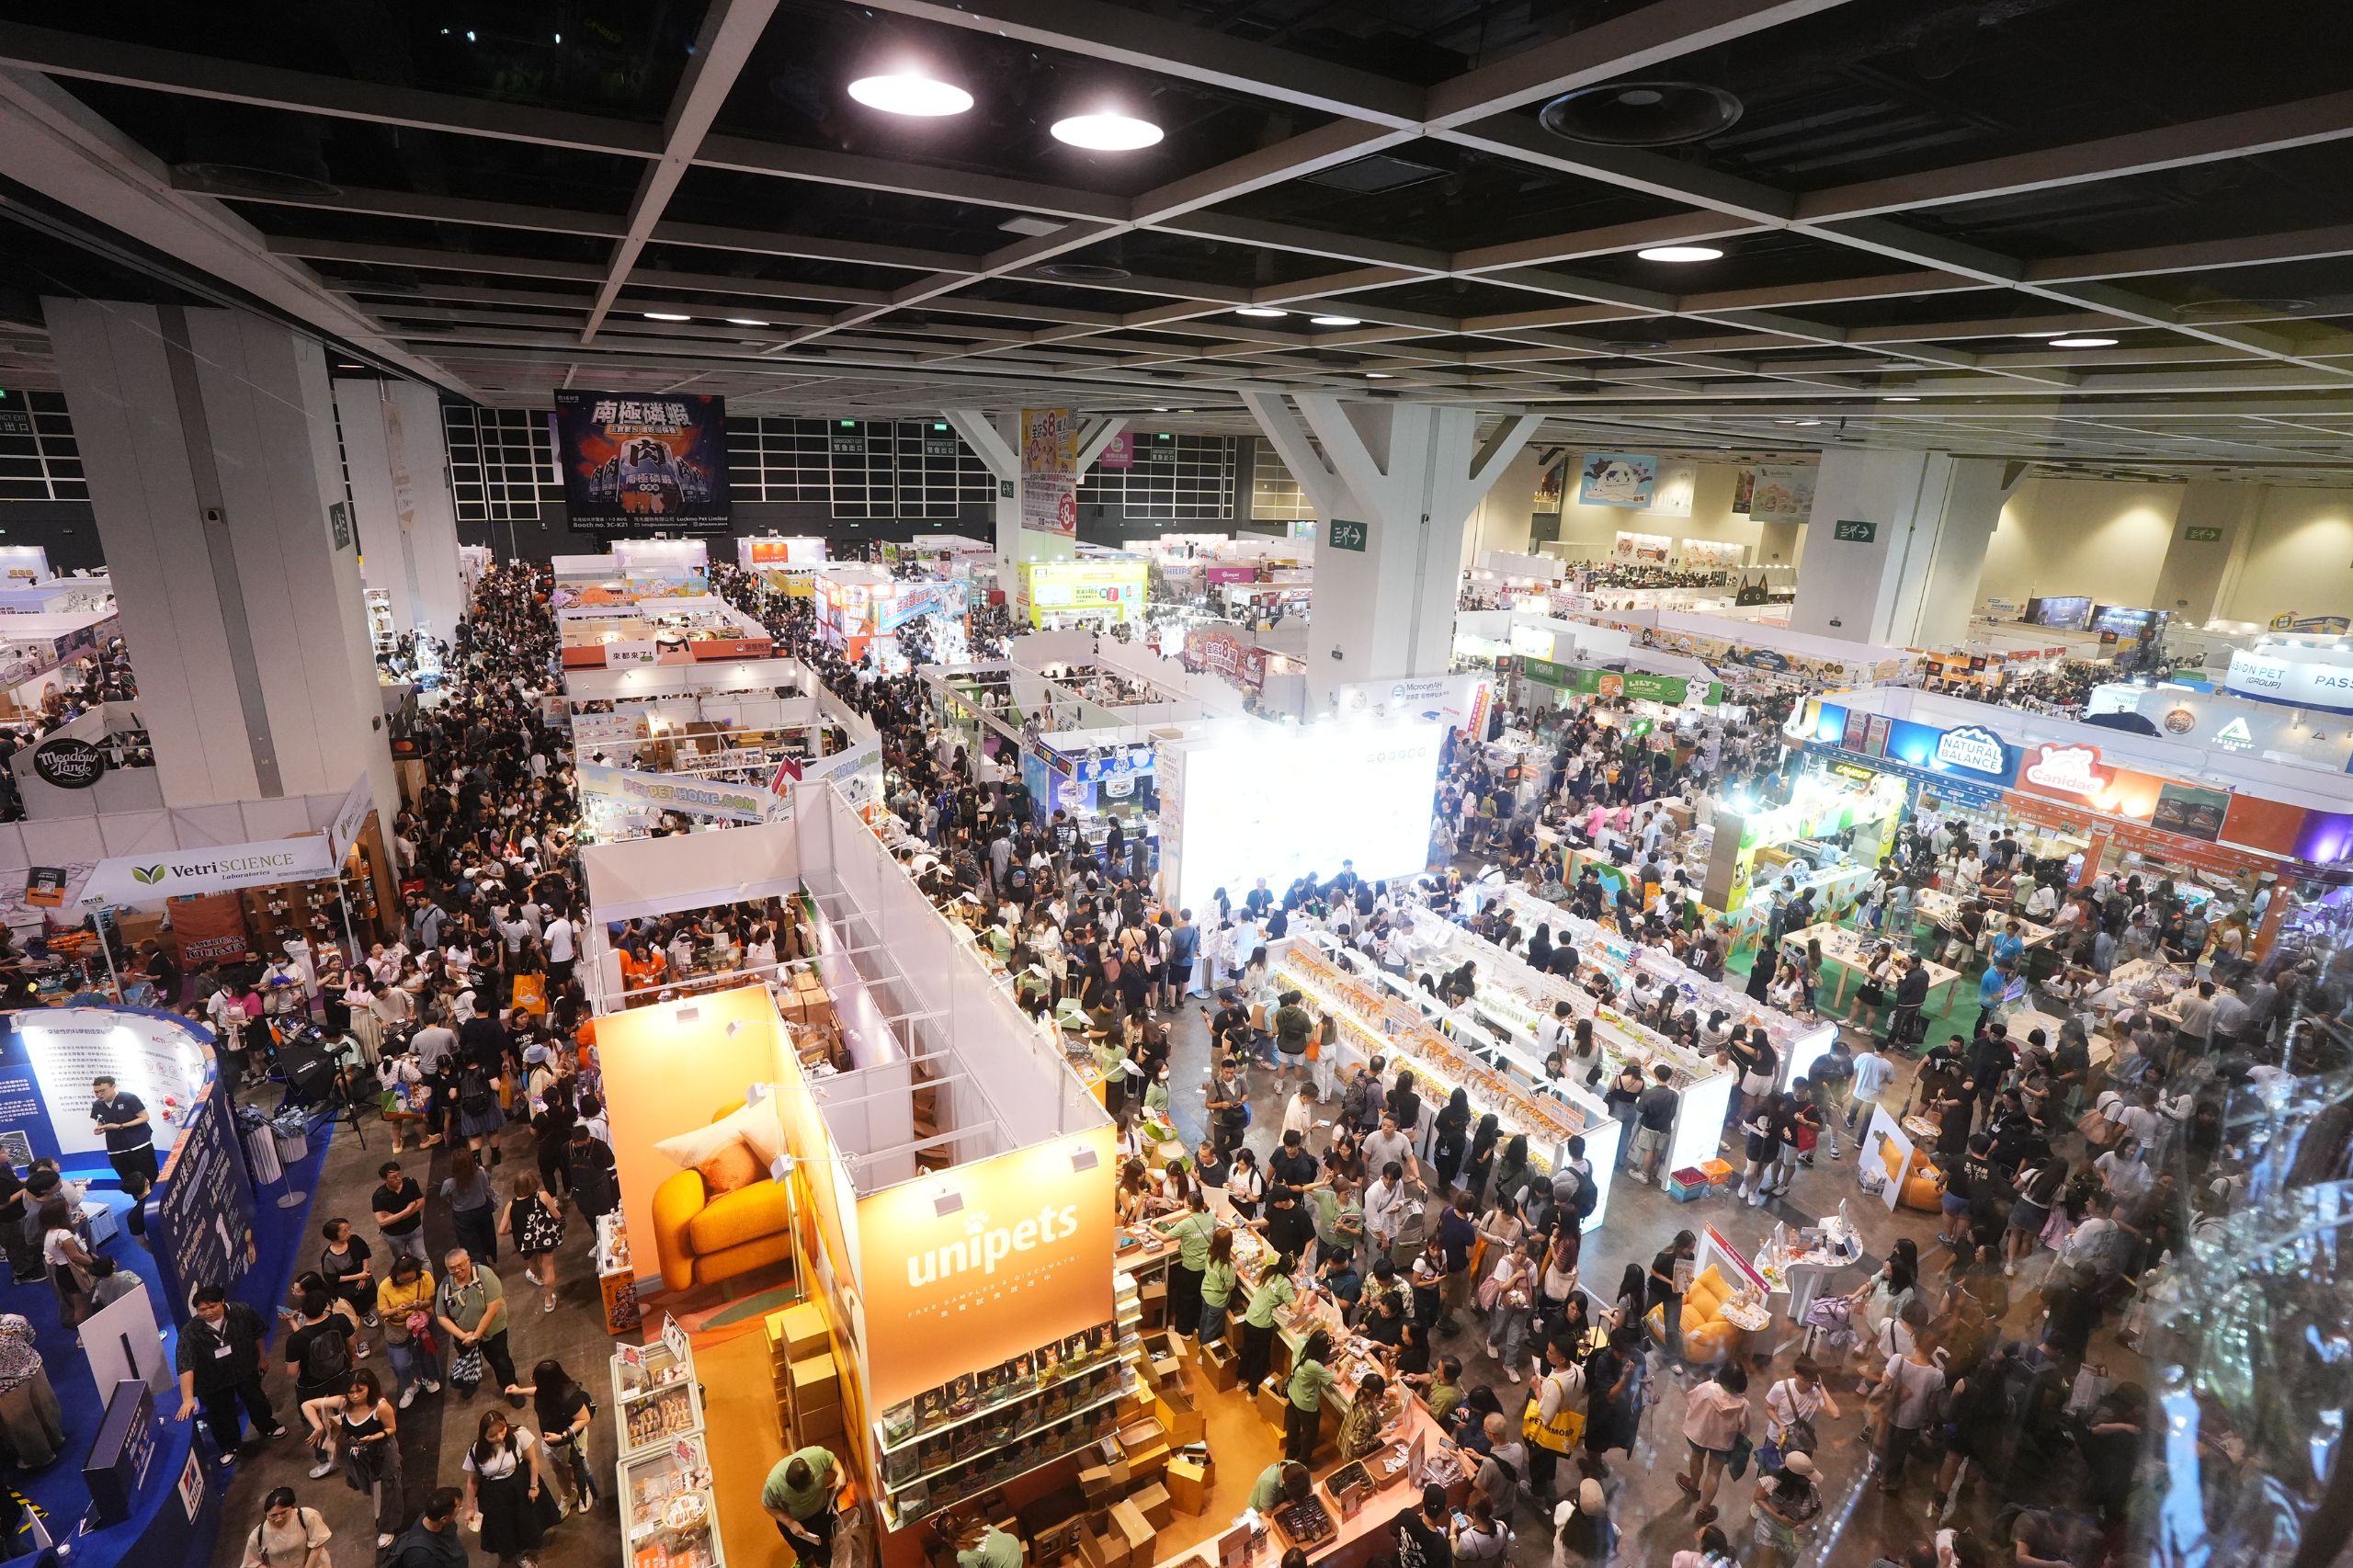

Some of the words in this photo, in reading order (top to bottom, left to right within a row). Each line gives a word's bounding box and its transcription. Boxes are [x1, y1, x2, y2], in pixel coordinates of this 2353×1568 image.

[592, 401, 691, 426] 南極磷蝦
[0, 422, 28, 432] 出口
[1162, 567, 1191, 575] PHILIPS
[1534, 663, 1553, 676] YORA
[2259, 667, 2285, 679] PET
[1406, 682, 1442, 690] MicrocynAH
[1629, 680, 1662, 690] LILY'S
[38, 747, 98, 766] Meadow
[1943, 737, 1999, 761] NATURAL
[1941, 750, 1998, 770] BALANCE
[51, 761, 91, 777] Land
[2031, 767, 2096, 792] Canidae
[222, 869, 270, 881] Laboratories
[1693, 949, 1708, 967] 97
[907, 1205, 1078, 1288] unipets
[907, 1303, 938, 1318] FREE
[944, 1283, 995, 1306] SAMPLES
[1015, 1254, 1080, 1281] GIVEAWAYS!
